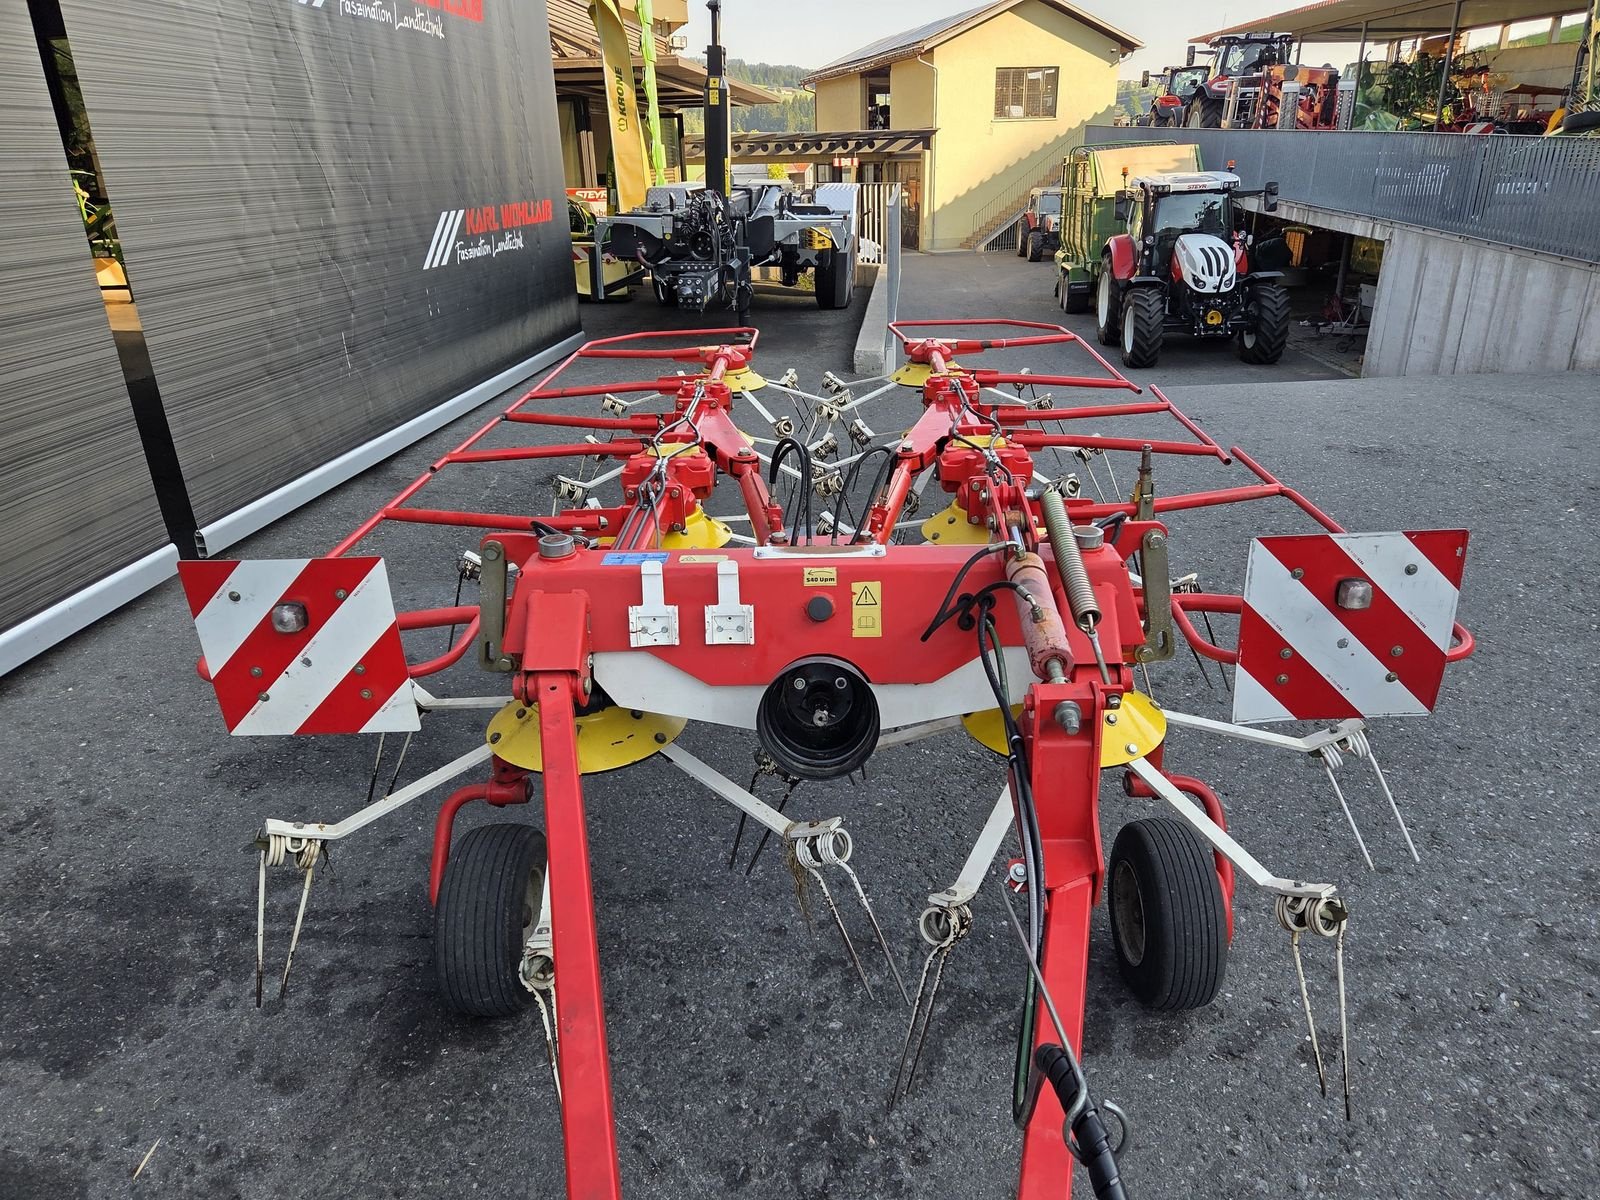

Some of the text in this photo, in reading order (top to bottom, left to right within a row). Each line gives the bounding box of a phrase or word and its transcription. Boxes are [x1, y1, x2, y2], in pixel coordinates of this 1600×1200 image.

[393, 1, 445, 39] Landtechnik
[614, 66, 627, 117] KRONE
[465, 206, 499, 235] KARL
[455, 229, 524, 265] Faszination Landtechnik
